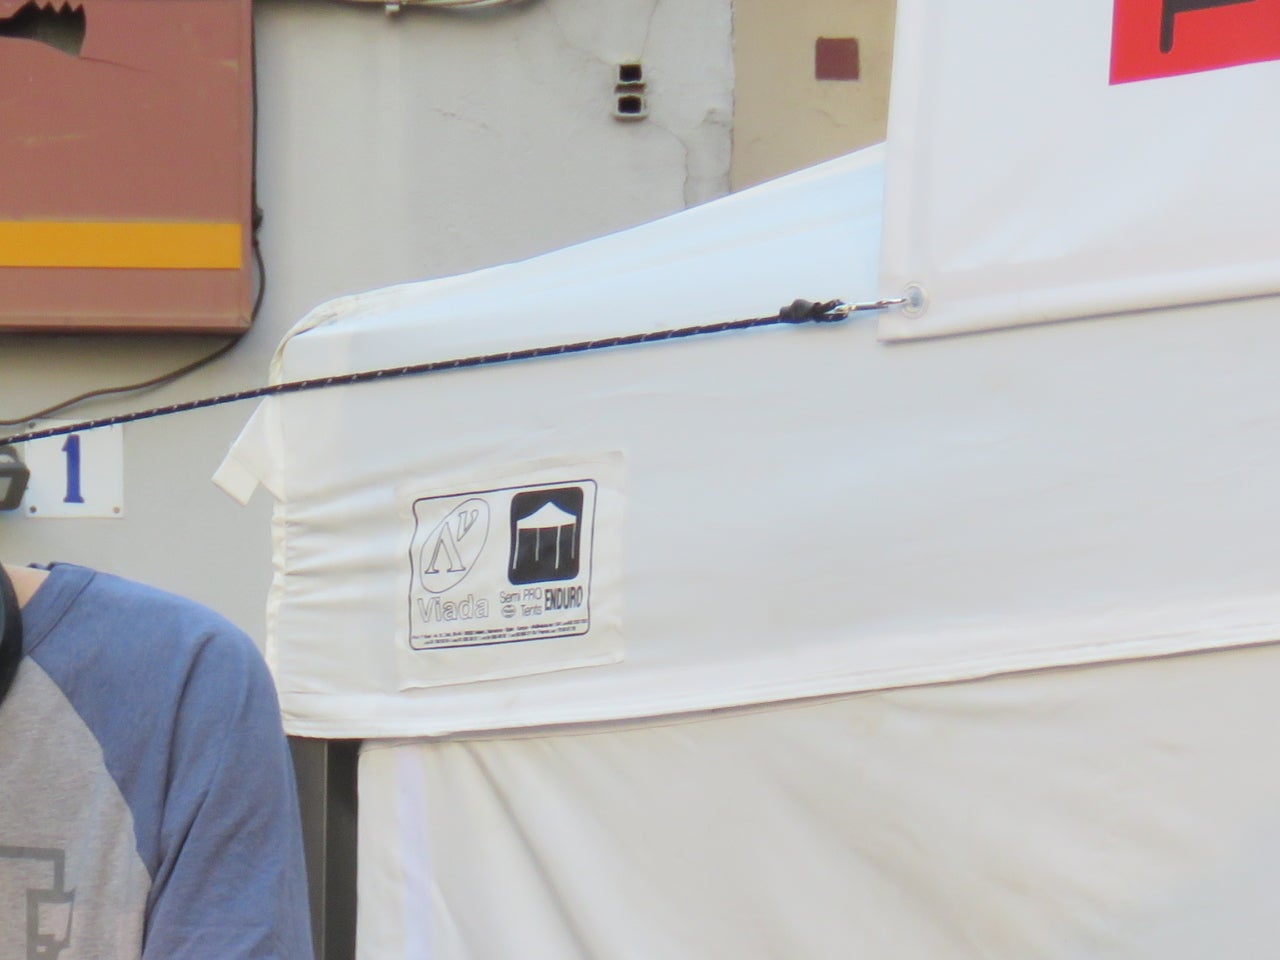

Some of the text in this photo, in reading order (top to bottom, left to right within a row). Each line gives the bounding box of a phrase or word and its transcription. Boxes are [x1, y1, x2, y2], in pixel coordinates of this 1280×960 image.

[61, 433, 85, 503] 1
[523, 587, 542, 600] PRO
[544, 586, 583, 611] ENDURO
[417, 594, 489, 623] Viada
